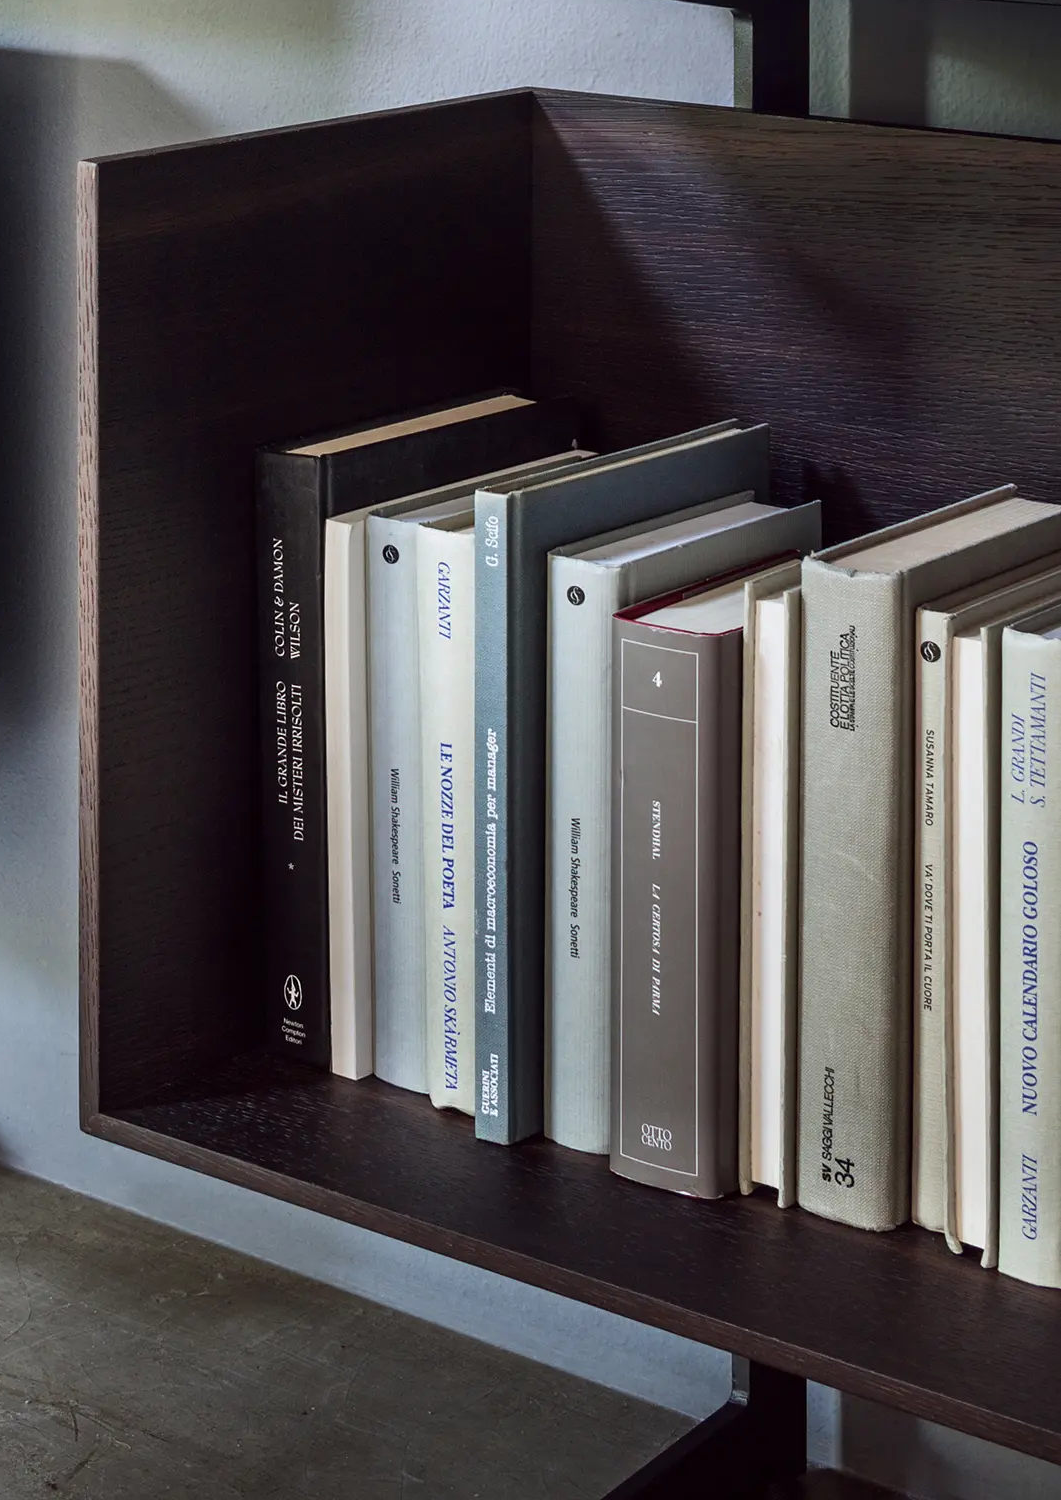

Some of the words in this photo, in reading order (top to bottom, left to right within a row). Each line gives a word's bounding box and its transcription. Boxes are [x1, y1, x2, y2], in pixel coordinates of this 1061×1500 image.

[485, 515, 499, 549] Scifo
[273, 538, 284, 593] DAMON
[486, 552, 499, 567] G.
[273, 598, 284, 607] &
[438, 561, 452, 640] GARZANTI
[274, 610, 285, 657] COLIN
[290, 602, 301, 659] WILSON
[839, 633, 850, 683] POLITICA
[652, 671, 663, 687] 4
[830, 650, 840, 728] COSTITUENTE
[276, 680, 287, 724] LIBRO
[290, 683, 303, 753] IRRISOLTI
[840, 686, 849, 720] LOTTA
[840, 721, 849, 730] E
[1029, 672, 1047, 792] TETTAMANTI
[277, 727, 288, 788] GRANDE
[440, 742, 452, 762] LE
[486, 728, 500, 791] manager
[925, 729, 935, 779] SUSANNA
[1011, 713, 1026, 783] GRANDI
[278, 791, 288, 804] IL
[292, 756, 304, 814] MISTERI
[390, 768, 401, 803] William
[440, 765, 454, 820] NOZZE
[1011, 789, 1026, 805] L.
[1031, 796, 1046, 808] S.
[486, 794, 500, 820] per
[925, 782, 934, 826] TAMARO
[293, 816, 304, 842] DEI
[391, 806, 401, 865] Shakespeare
[441, 824, 455, 854] DEL
[570, 818, 582, 855] William
[652, 800, 662, 860] STENDHAL
[391, 870, 402, 904] Sonetti
[442, 857, 455, 910] POETA
[485, 822, 498, 933] macroeconomia
[570, 857, 582, 918] Shakespeare
[924, 864, 933, 881] VA'
[1023, 841, 1039, 919] GOLOSO
[651, 882, 661, 901] LA
[924, 884, 934, 912] DOVE
[651, 903, 661, 957] CERTOSA
[924, 915, 933, 925] TI
[485, 935, 497, 949] di
[570, 923, 580, 959] Sonetti
[924, 926, 933, 961] PORTA
[443, 925, 457, 1002] ANTONIO
[651, 958, 661, 973] DI
[924, 964, 933, 973] IL
[485, 951, 497, 1014] Elementi
[651, 975, 661, 1016] PARMA
[923, 976, 933, 1011] CUORE
[1022, 923, 1039, 1042] CALENDARIO
[281, 1025, 306, 1038] Compton
[283, 1017, 304, 1029] Newton
[481, 1070, 491, 1114] GUERINI
[489, 1053, 500, 1107] ASSOCIATI
[823, 1067, 835, 1127] VALLECCHI
[1022, 1046, 1038, 1116] NUOVO
[489, 1108, 499, 1117] E
[641, 1123, 672, 1142] OTTO
[641, 1135, 672, 1151] CENTO
[822, 1127, 834, 1161] SAGGI
[822, 1166, 832, 1182] SV
[835, 1157, 855, 1188] 34
[1022, 1154, 1038, 1241] GARZANTI
